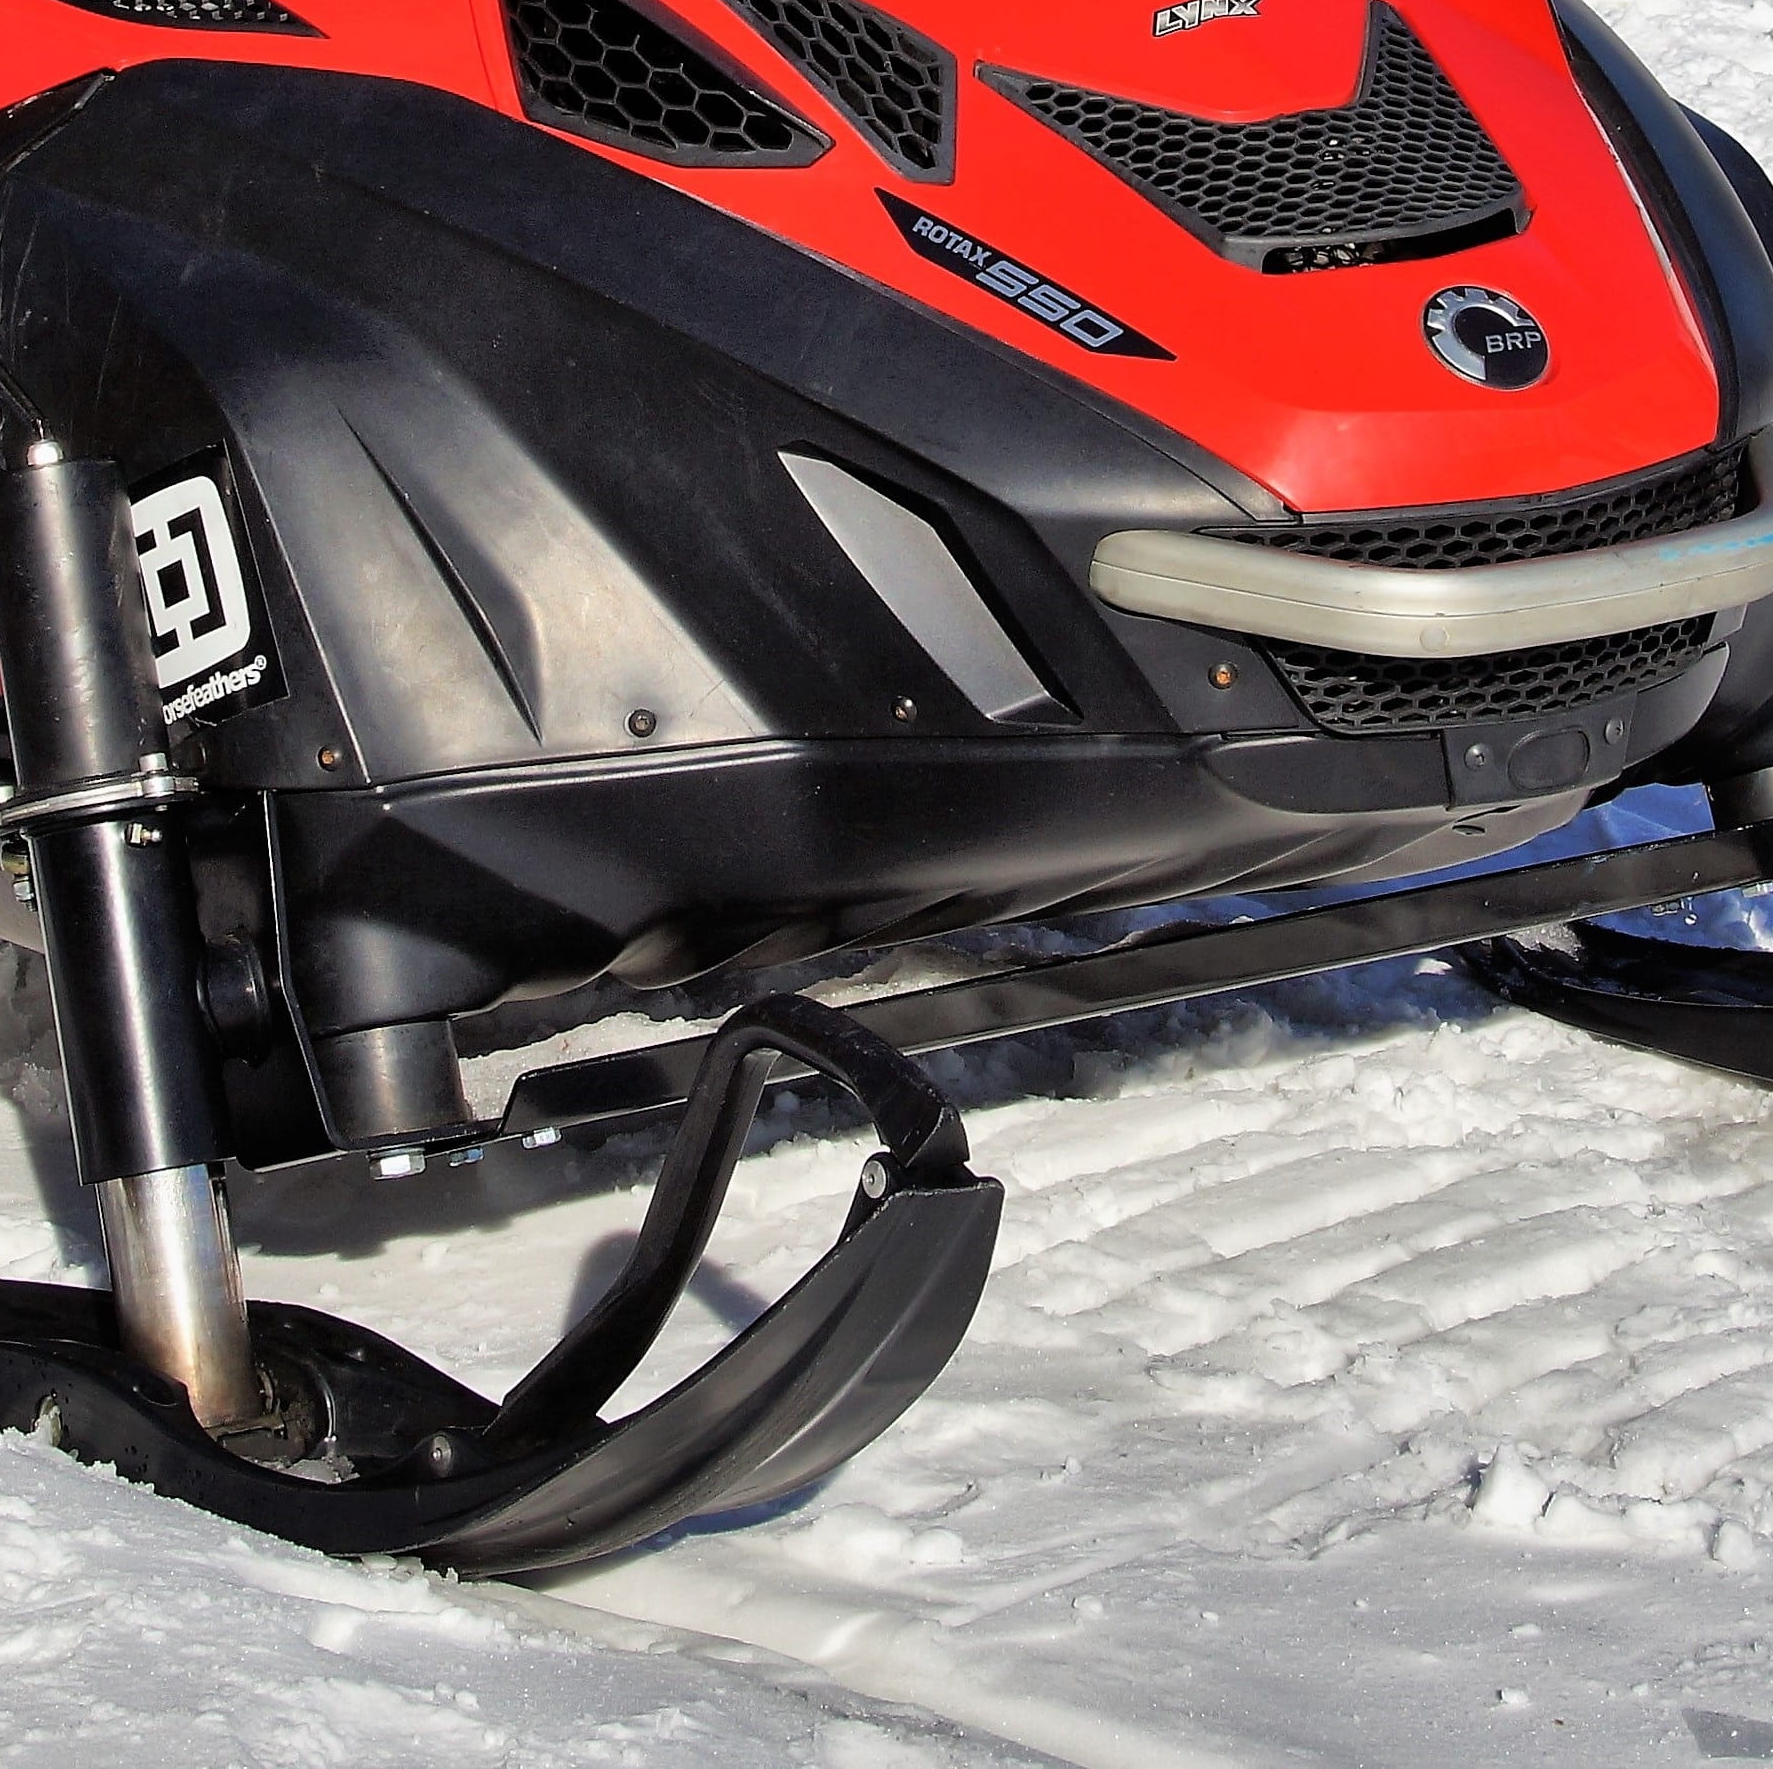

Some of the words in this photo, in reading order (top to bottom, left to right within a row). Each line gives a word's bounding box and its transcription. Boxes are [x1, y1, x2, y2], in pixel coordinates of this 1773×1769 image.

[912, 215, 993, 267] ROTAX
[975, 259, 1125, 349] 550
[1485, 331, 1542, 354] BRP
